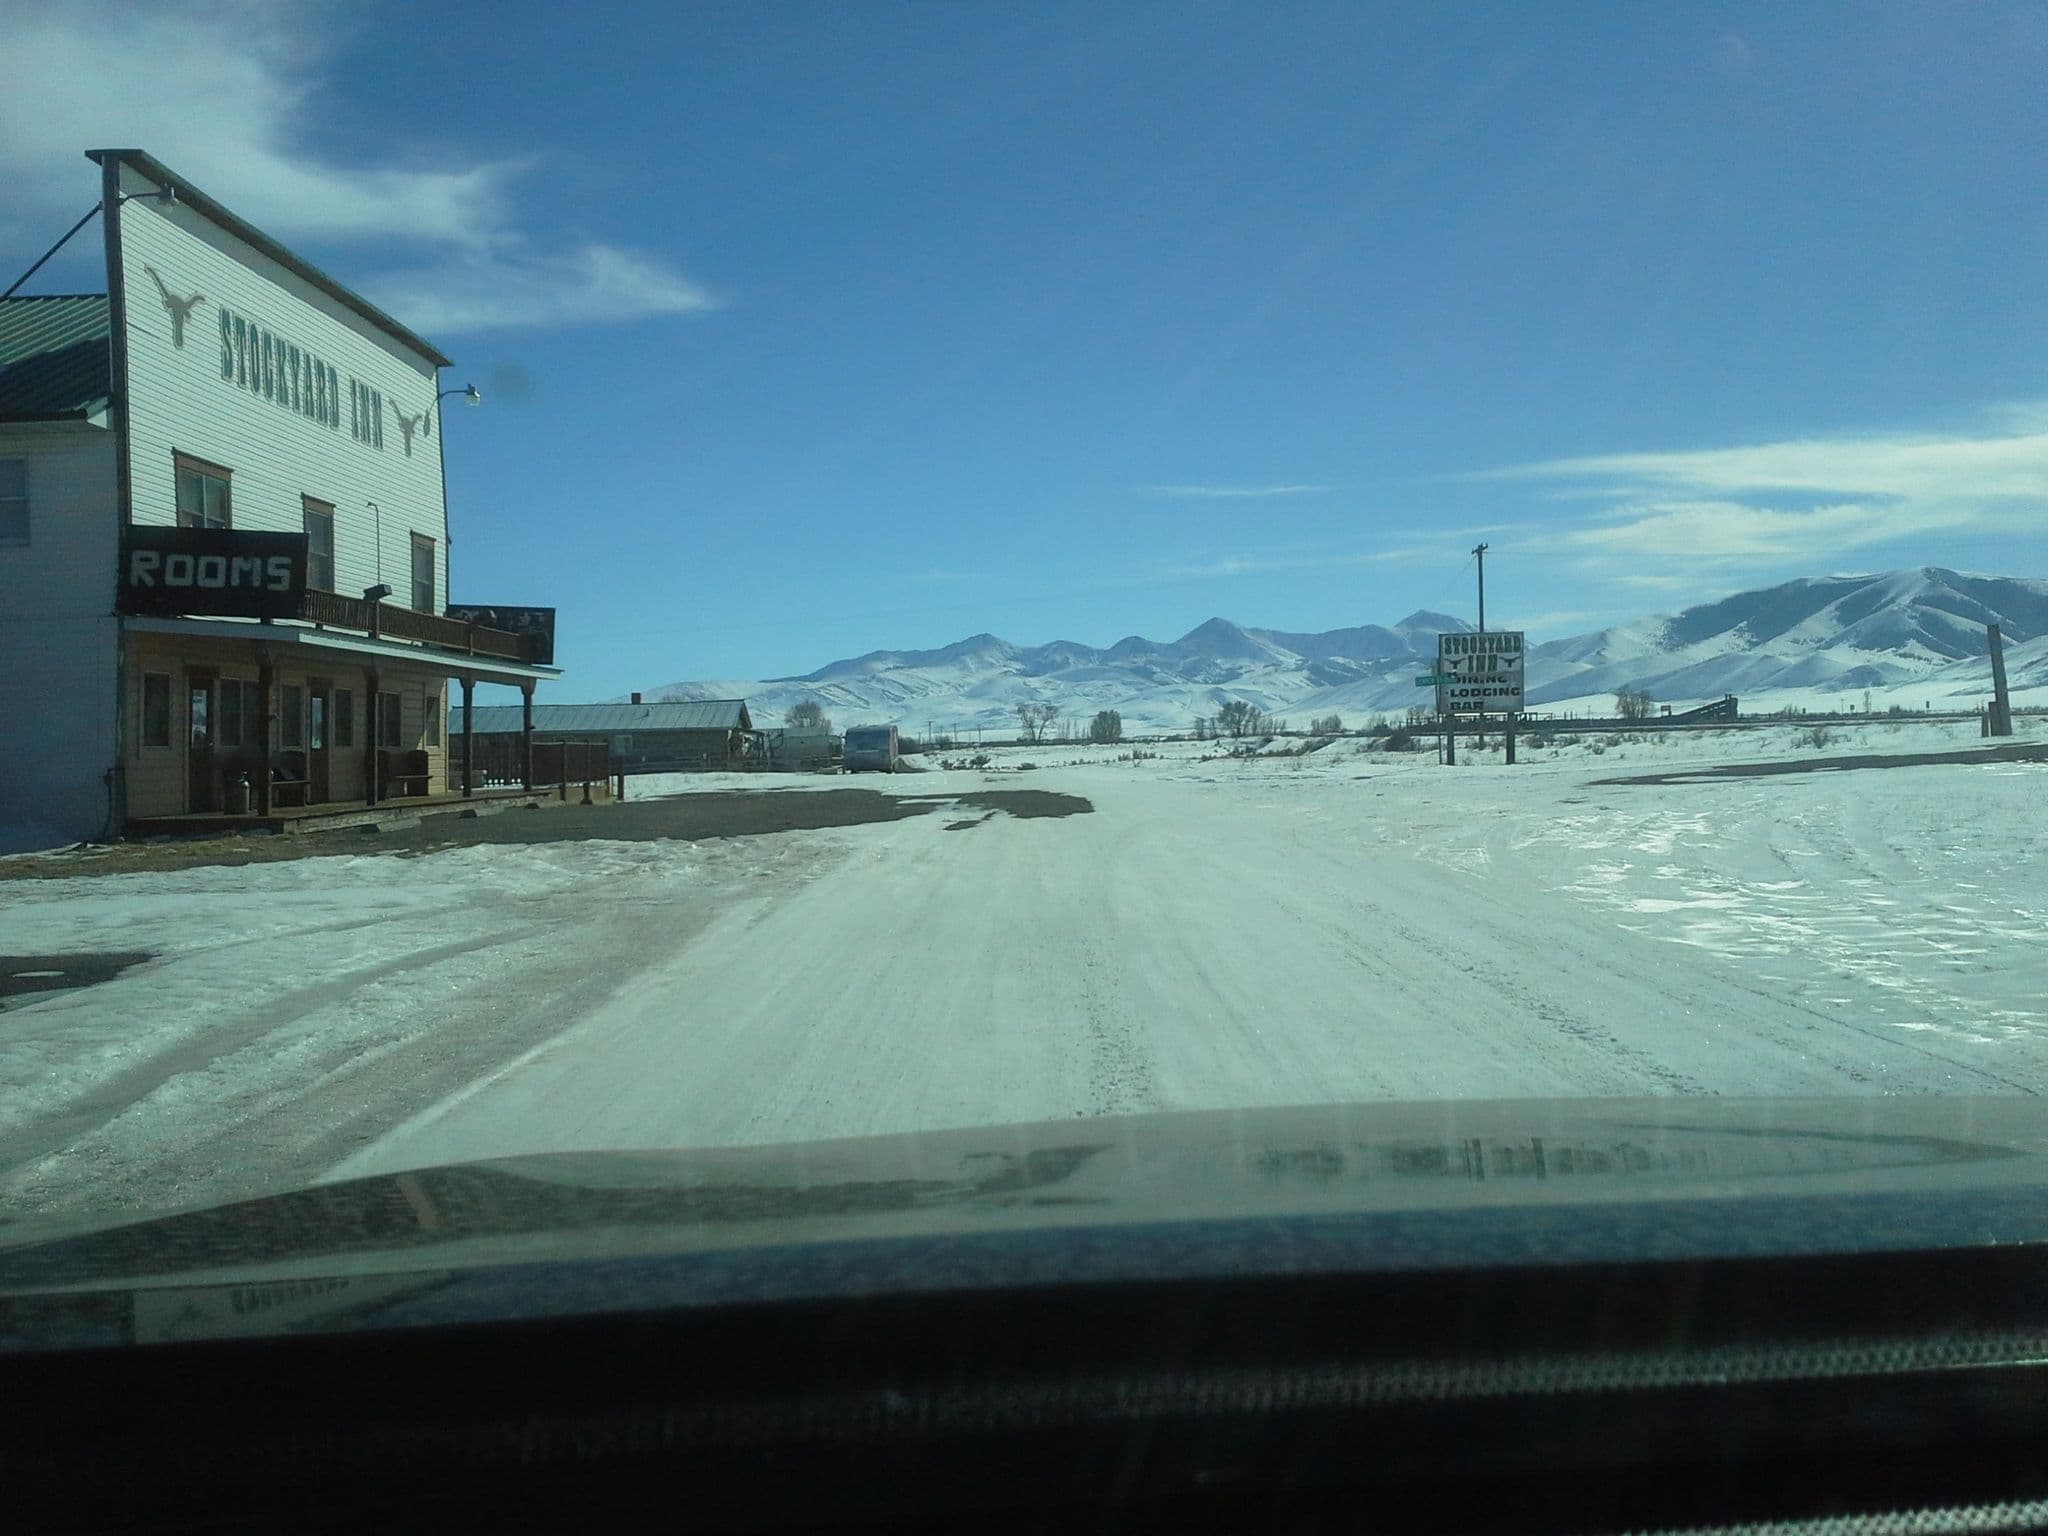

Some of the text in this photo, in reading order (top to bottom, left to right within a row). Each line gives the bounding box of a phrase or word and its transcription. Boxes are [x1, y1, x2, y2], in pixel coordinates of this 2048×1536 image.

[220, 307, 383, 450] STOCKYARD INN
[130, 549, 292, 591] ROOMS
[1444, 635, 1521, 655] STOCKYARD
[1467, 654, 1498, 673] INN
[1450, 687, 1520, 698] LODGING
[1450, 701, 1484, 711] BAR
